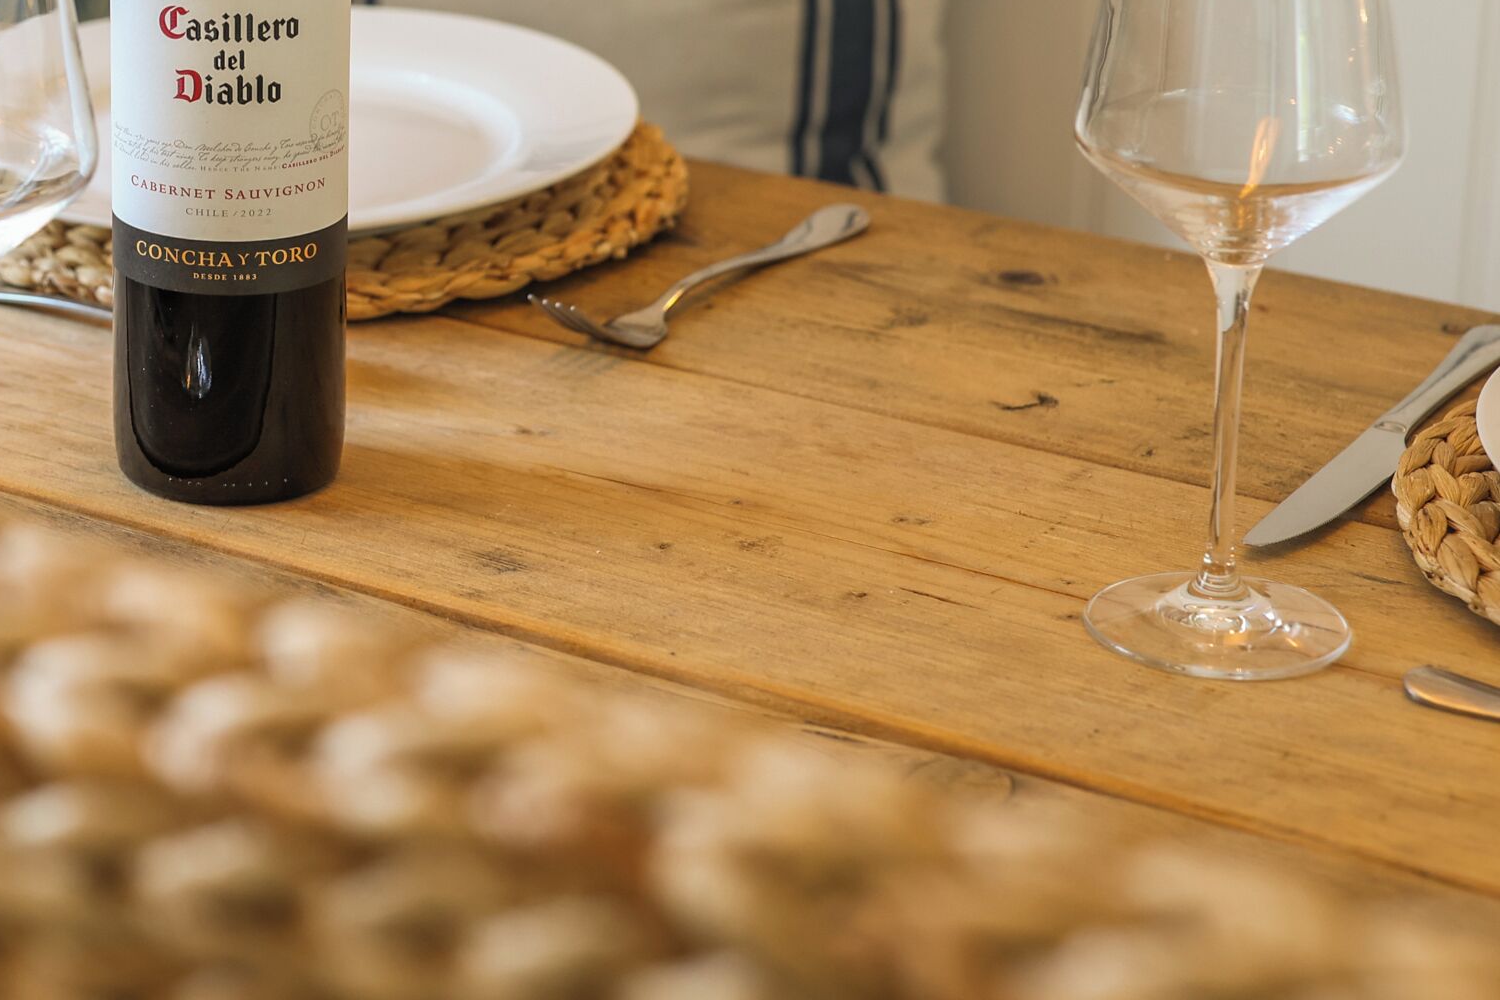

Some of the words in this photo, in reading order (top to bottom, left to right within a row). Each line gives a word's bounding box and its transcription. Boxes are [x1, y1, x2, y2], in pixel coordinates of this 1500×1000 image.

[158, 5, 299, 43] Casillero
[213, 49, 246, 71] del
[173, 69, 281, 105] Diablo
[130, 174, 216, 200] CABERNET
[224, 177, 326, 200] SAUVIGNON
[136, 239, 234, 268] CONCHA
[237, 253, 250, 266] Y
[254, 242, 318, 267] TORO
[193, 272, 227, 281] DESDE
[233, 273, 258, 281] 1883
